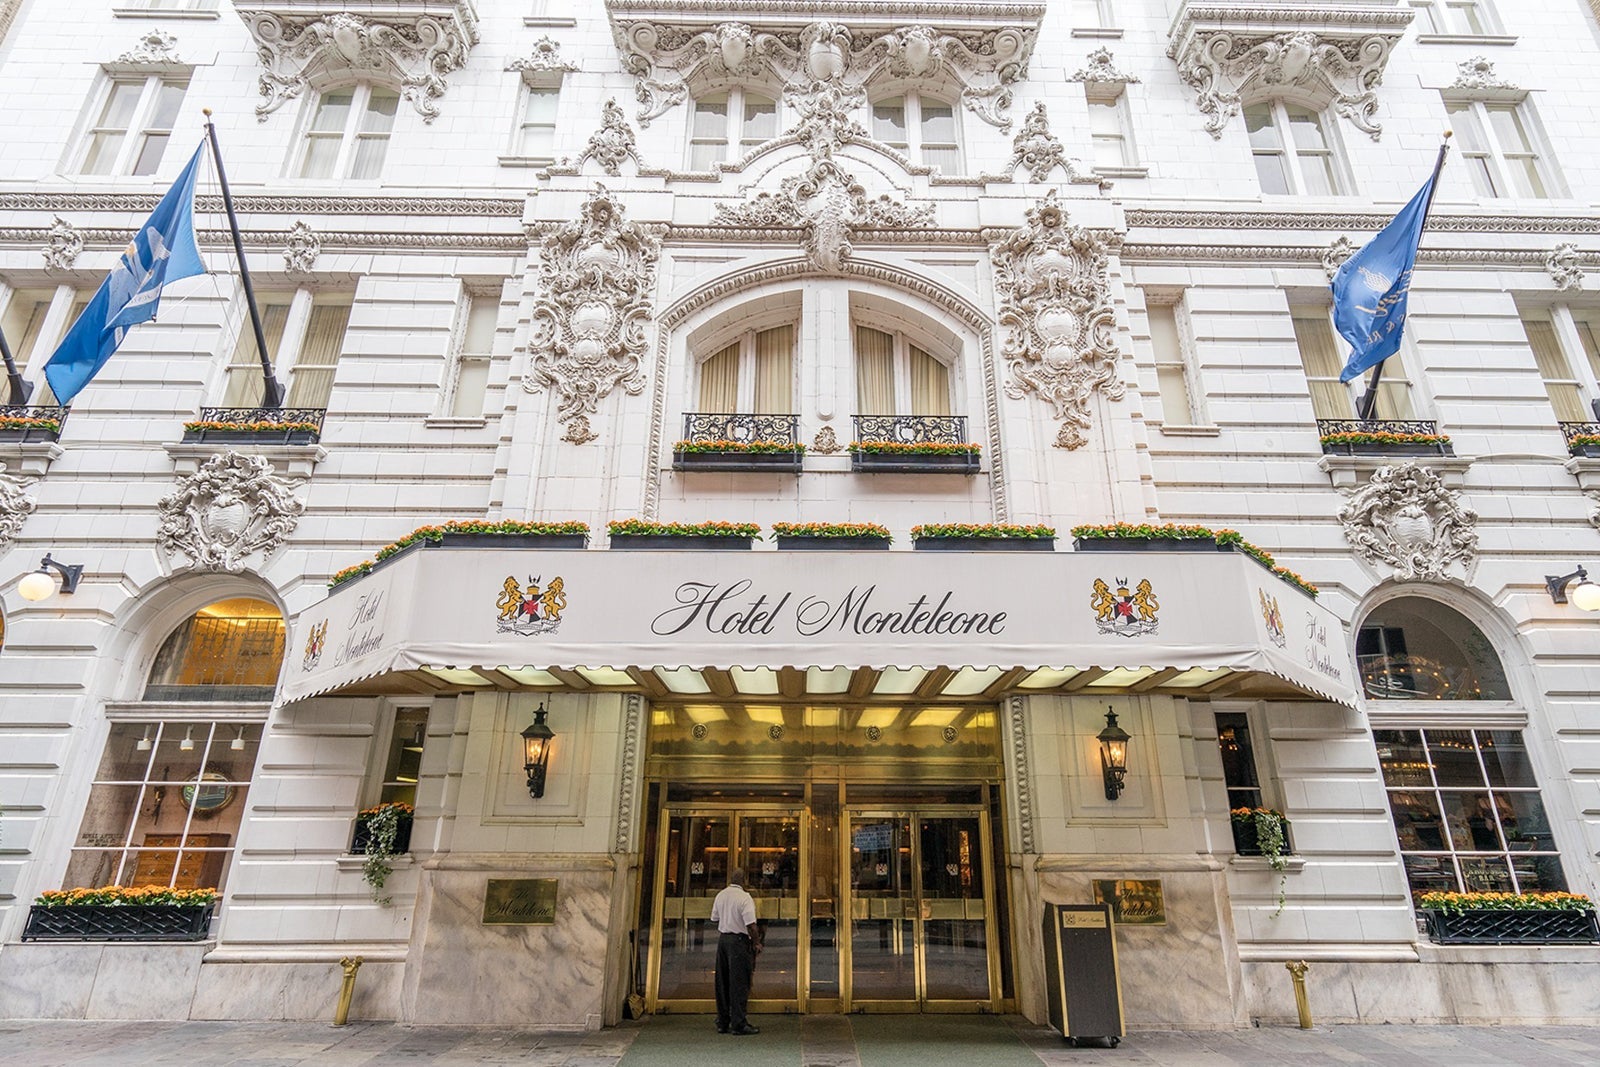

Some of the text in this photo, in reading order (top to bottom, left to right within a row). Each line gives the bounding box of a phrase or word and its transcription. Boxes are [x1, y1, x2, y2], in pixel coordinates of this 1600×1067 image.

[348, 588, 385, 630] Hotel
[650, 579, 1009, 636] Hotel Monteleone
[1304, 610, 1328, 648] Hotel
